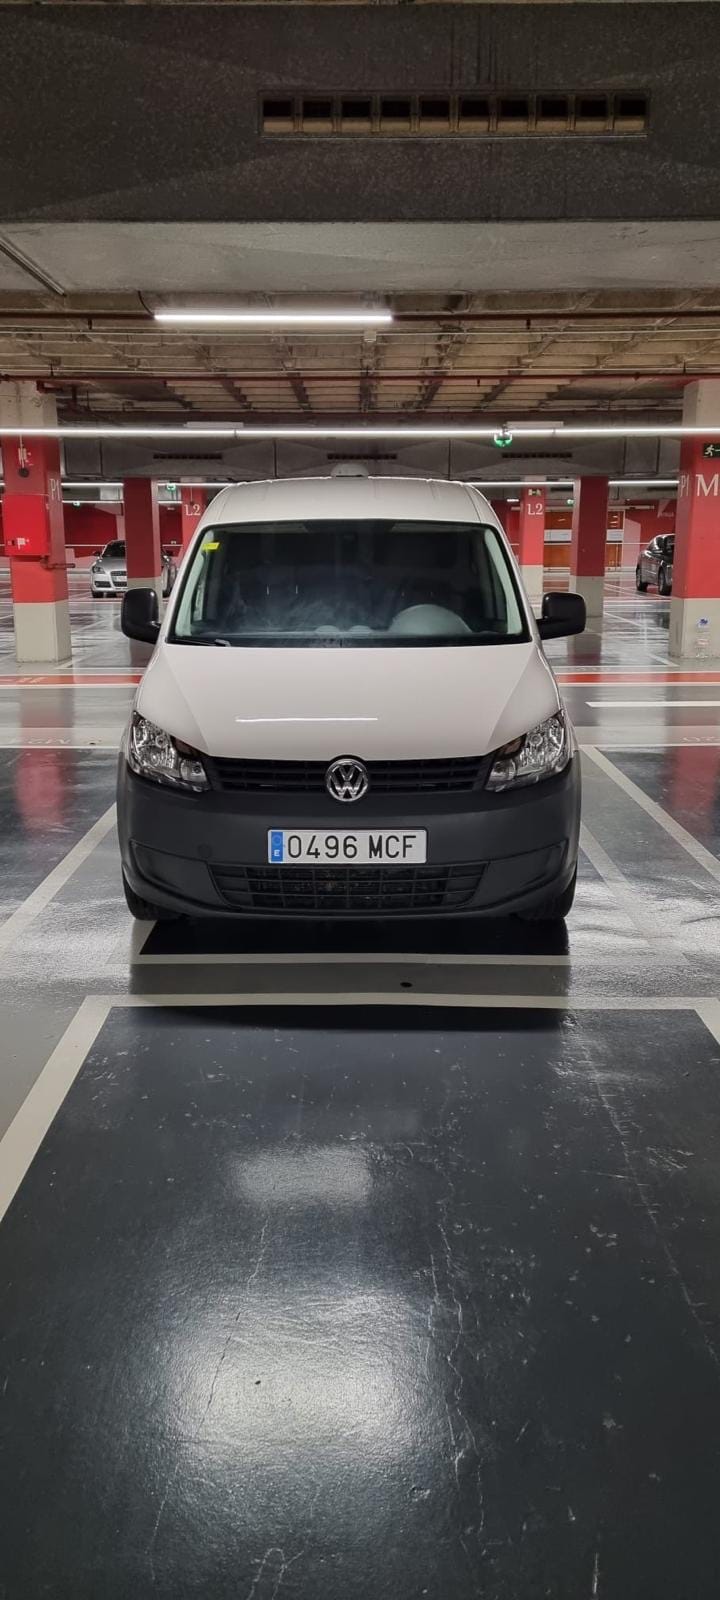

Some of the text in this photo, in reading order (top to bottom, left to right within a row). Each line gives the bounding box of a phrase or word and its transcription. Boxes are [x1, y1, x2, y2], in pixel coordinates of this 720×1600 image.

[50, 478, 61, 501] P1
[184, 503, 201, 516] L2
[526, 503, 543, 515] L2
[274, 849, 281, 857] E
[287, 834, 417, 859] 0496 MCF
